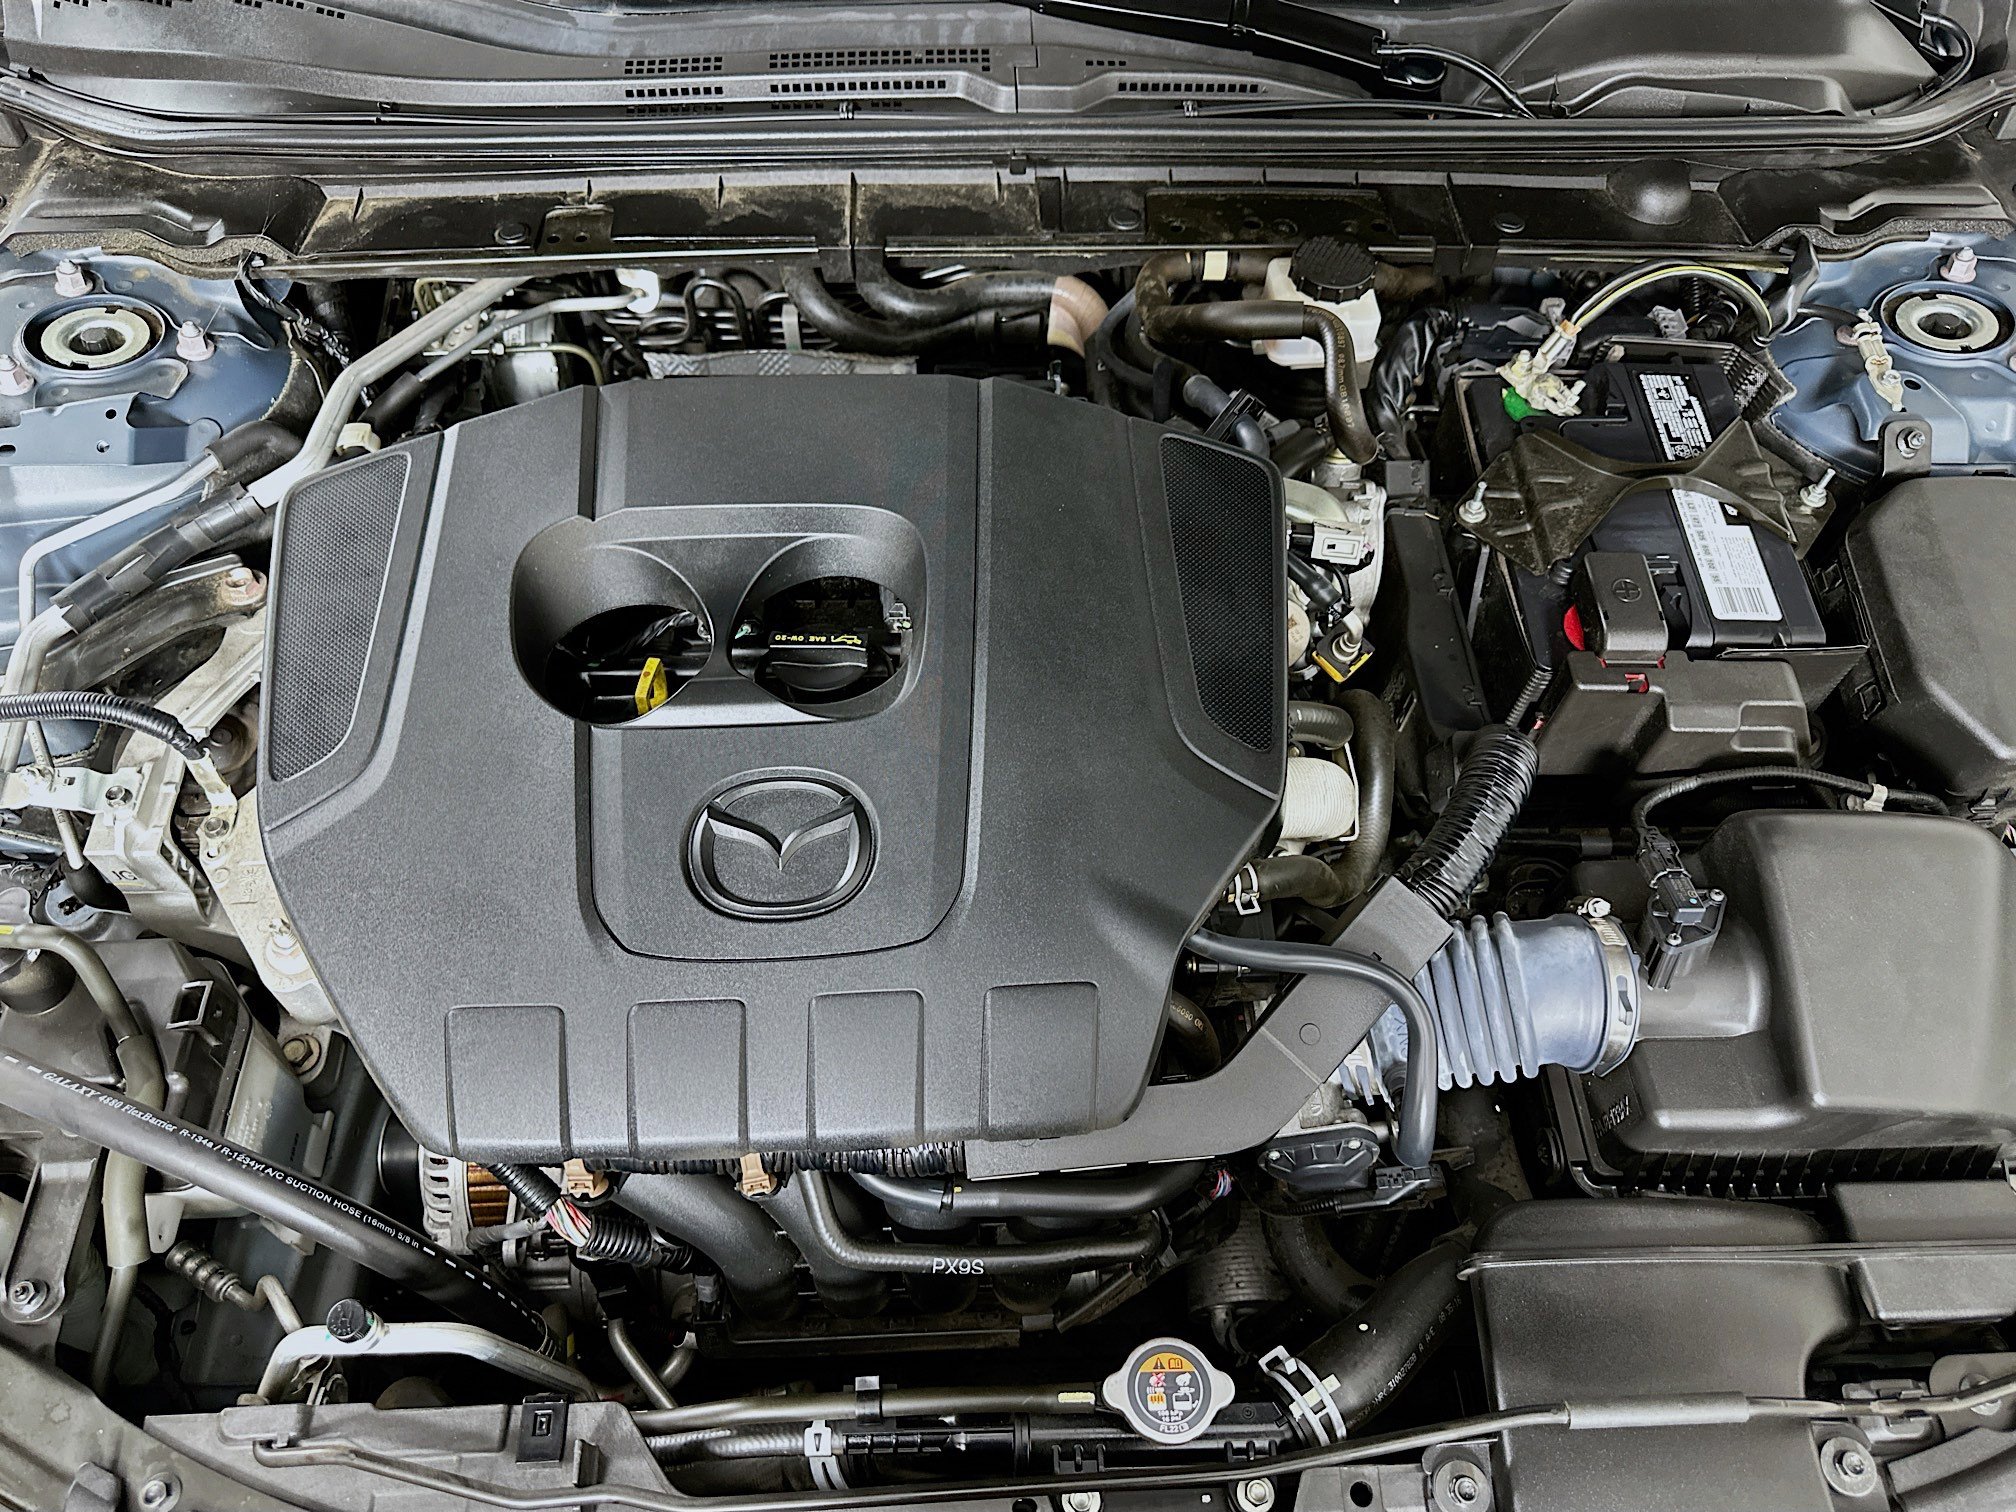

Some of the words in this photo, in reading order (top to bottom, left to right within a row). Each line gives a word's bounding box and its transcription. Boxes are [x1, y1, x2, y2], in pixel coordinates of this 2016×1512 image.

[42, 1072, 101, 1098] GALAXY
[98, 1094, 124, 1109] 4880
[121, 1103, 178, 1132] FlexBarrier
[179, 1128, 215, 1149] R-134a
[220, 1146, 266, 1171] R-1234yf
[264, 1166, 285, 1181] A/C
[285, 1176, 332, 1203] SUCTION
[333, 1198, 362, 1219] HOSE
[362, 1213, 396, 1237] (16mm)
[397, 1231, 411, 1244] 5/8
[411, 1239, 420, 1249] in
[932, 1256, 985, 1275] PX9S
[1159, 1424, 1180, 1433] FL22
